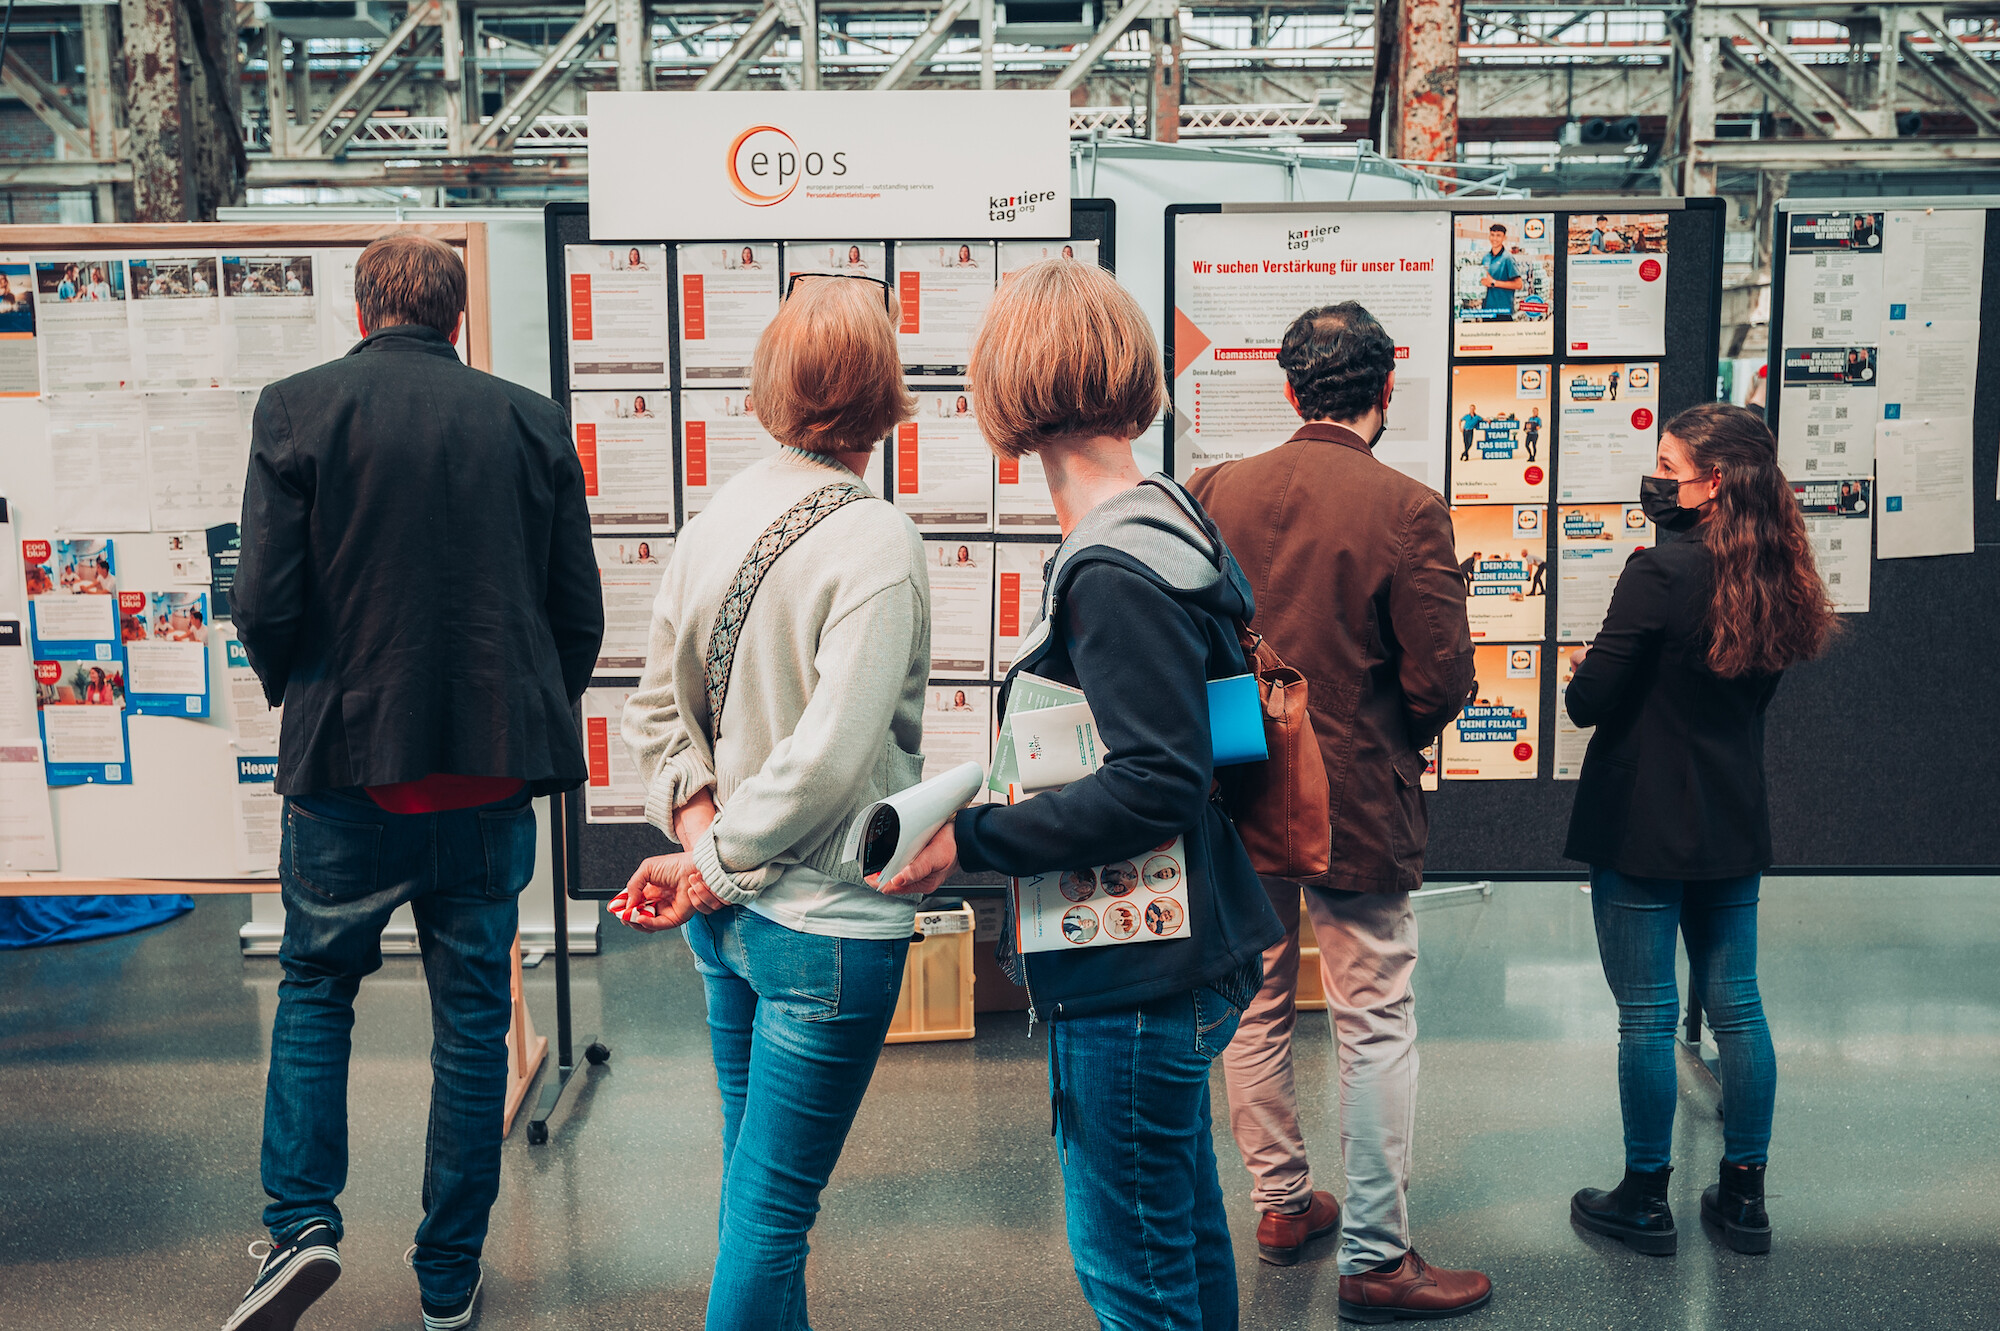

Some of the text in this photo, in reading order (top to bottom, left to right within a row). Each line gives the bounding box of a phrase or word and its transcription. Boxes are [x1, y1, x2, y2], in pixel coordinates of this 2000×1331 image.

[751, 152, 847, 186] epos
[990, 190, 1055, 209] karriere
[989, 209, 1015, 222] tag
[1288, 224, 1340, 239] karriere
[1288, 240, 1309, 250] tag
[1193, 258, 1434, 275] Wir suchen Verstärkung für unser Team!
[1216, 350, 1277, 359] Teamassistenz
[1460, 720, 1486, 728] DEINE
[241, 761, 278, 778] Heavy
